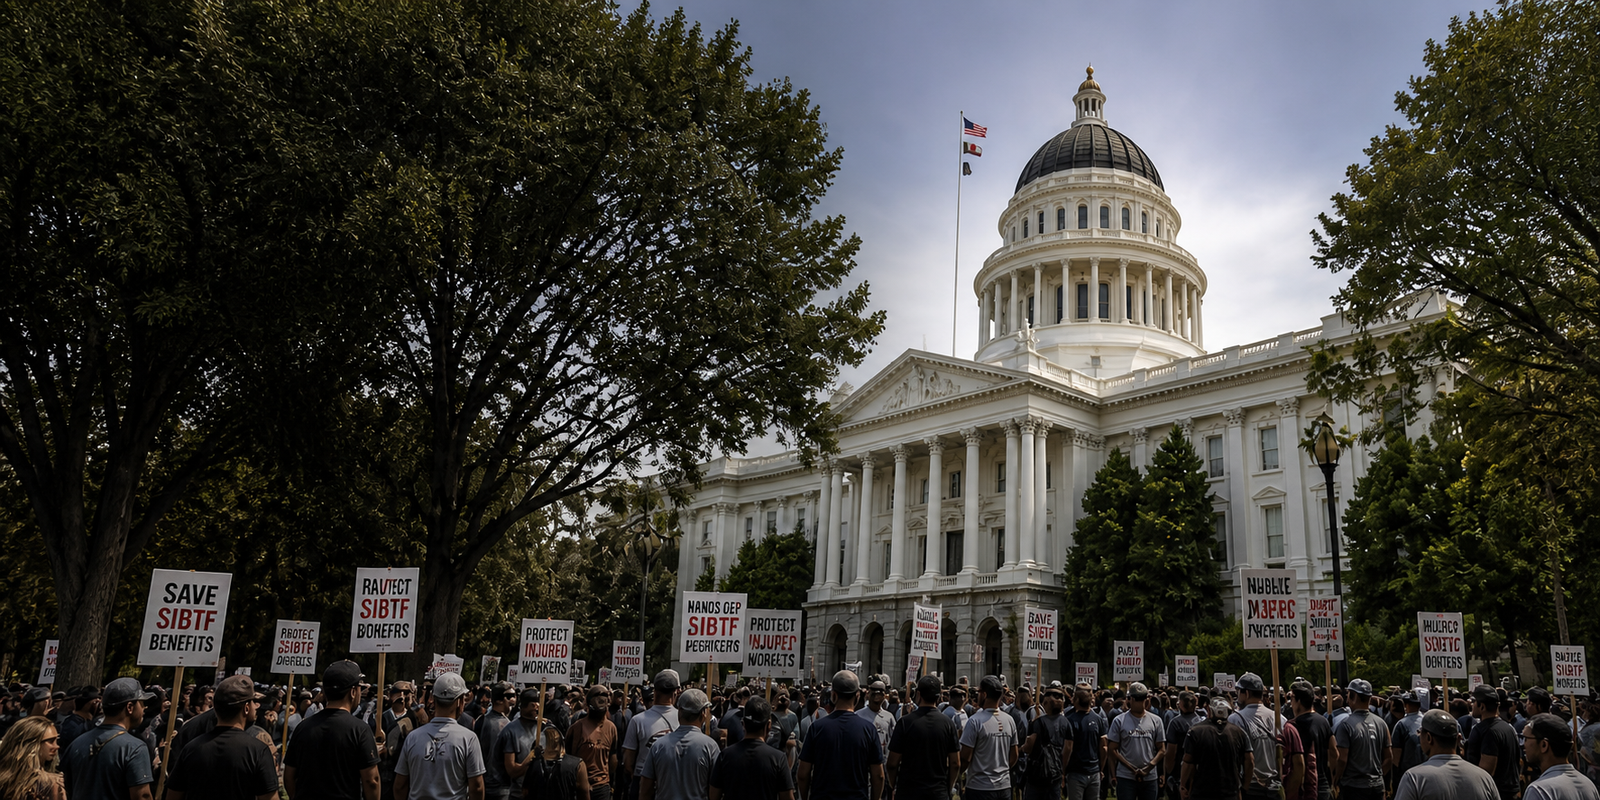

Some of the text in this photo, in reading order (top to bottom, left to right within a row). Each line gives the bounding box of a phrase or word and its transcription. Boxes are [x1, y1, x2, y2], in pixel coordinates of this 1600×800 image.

[163, 583, 219, 606] SAVE
[360, 598, 410, 619] SIBTF
[156, 607, 218, 631] SIBTF
[688, 616, 740, 636] SIBTF
[750, 617, 797, 632] PROTECT
[149, 633, 215, 652] BENEFITS
[526, 627, 570, 641] PROTECT
[525, 643, 568, 658] INJURED
[522, 660, 568, 675] WORKERS
